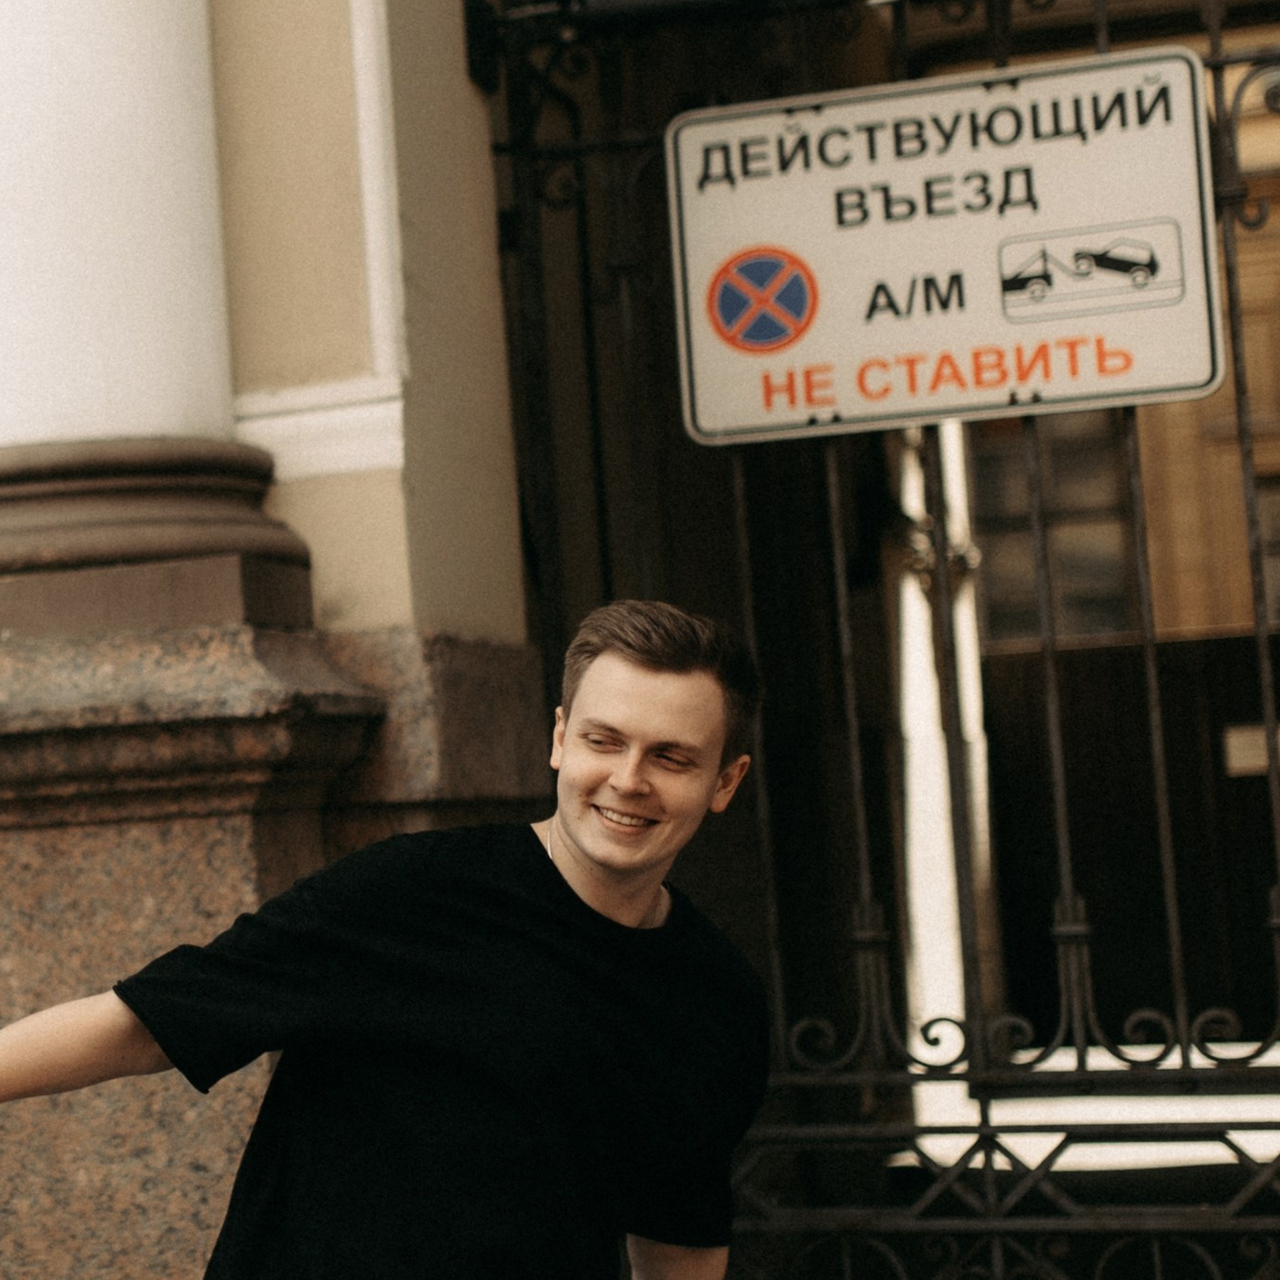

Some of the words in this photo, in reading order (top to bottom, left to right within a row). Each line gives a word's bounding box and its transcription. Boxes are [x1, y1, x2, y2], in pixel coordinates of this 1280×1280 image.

[697, 73, 1173, 192] ДЕЙСТВУЮЩИЙ
[834, 166, 1040, 228] ВЪЕЗД
[865, 272, 966, 322] А/М
[761, 364, 836, 413] НЕ
[856, 335, 1134, 402] СТАВИТЬ
